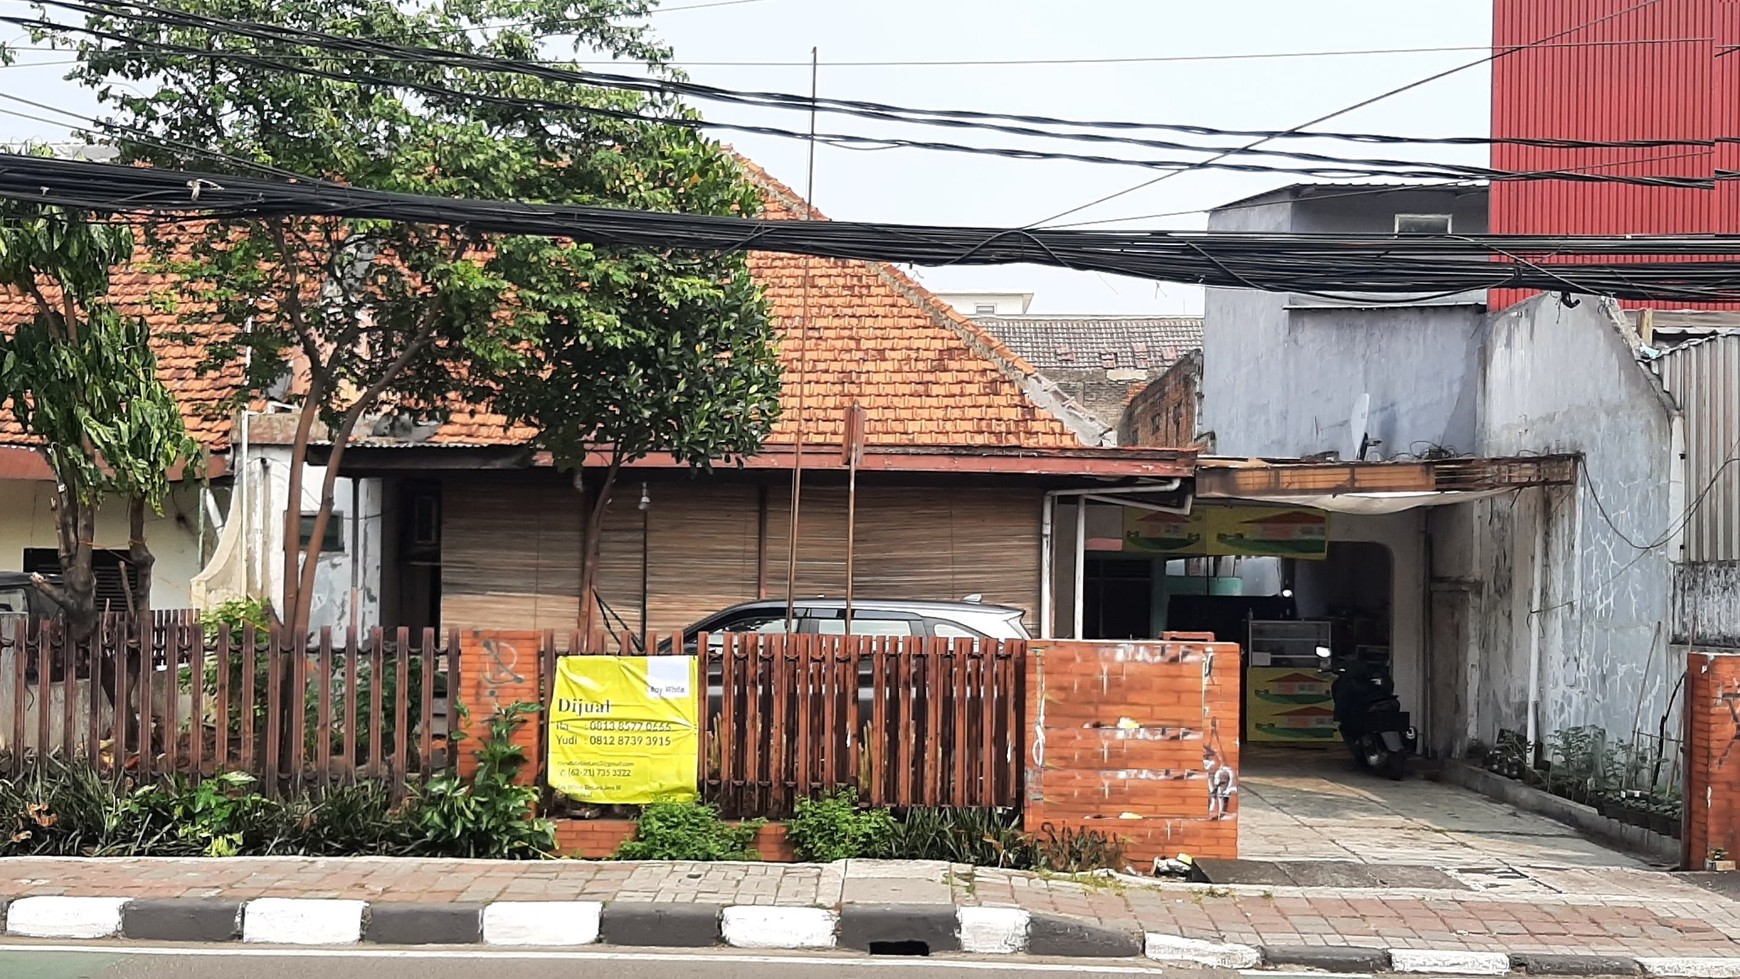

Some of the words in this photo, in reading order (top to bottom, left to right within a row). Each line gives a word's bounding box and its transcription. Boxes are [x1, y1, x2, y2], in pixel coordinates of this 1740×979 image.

[558, 698, 610, 716] Dijual
[589, 720, 615, 731] 0813
[618, 720, 643, 732] 8577
[556, 735, 578, 745] Yudi
[589, 736, 616, 746] 0812
[618, 736, 643, 746] 8739
[646, 736, 671, 747] 3915
[597, 769, 611, 777] 735
[612, 769, 631, 777] 3322
